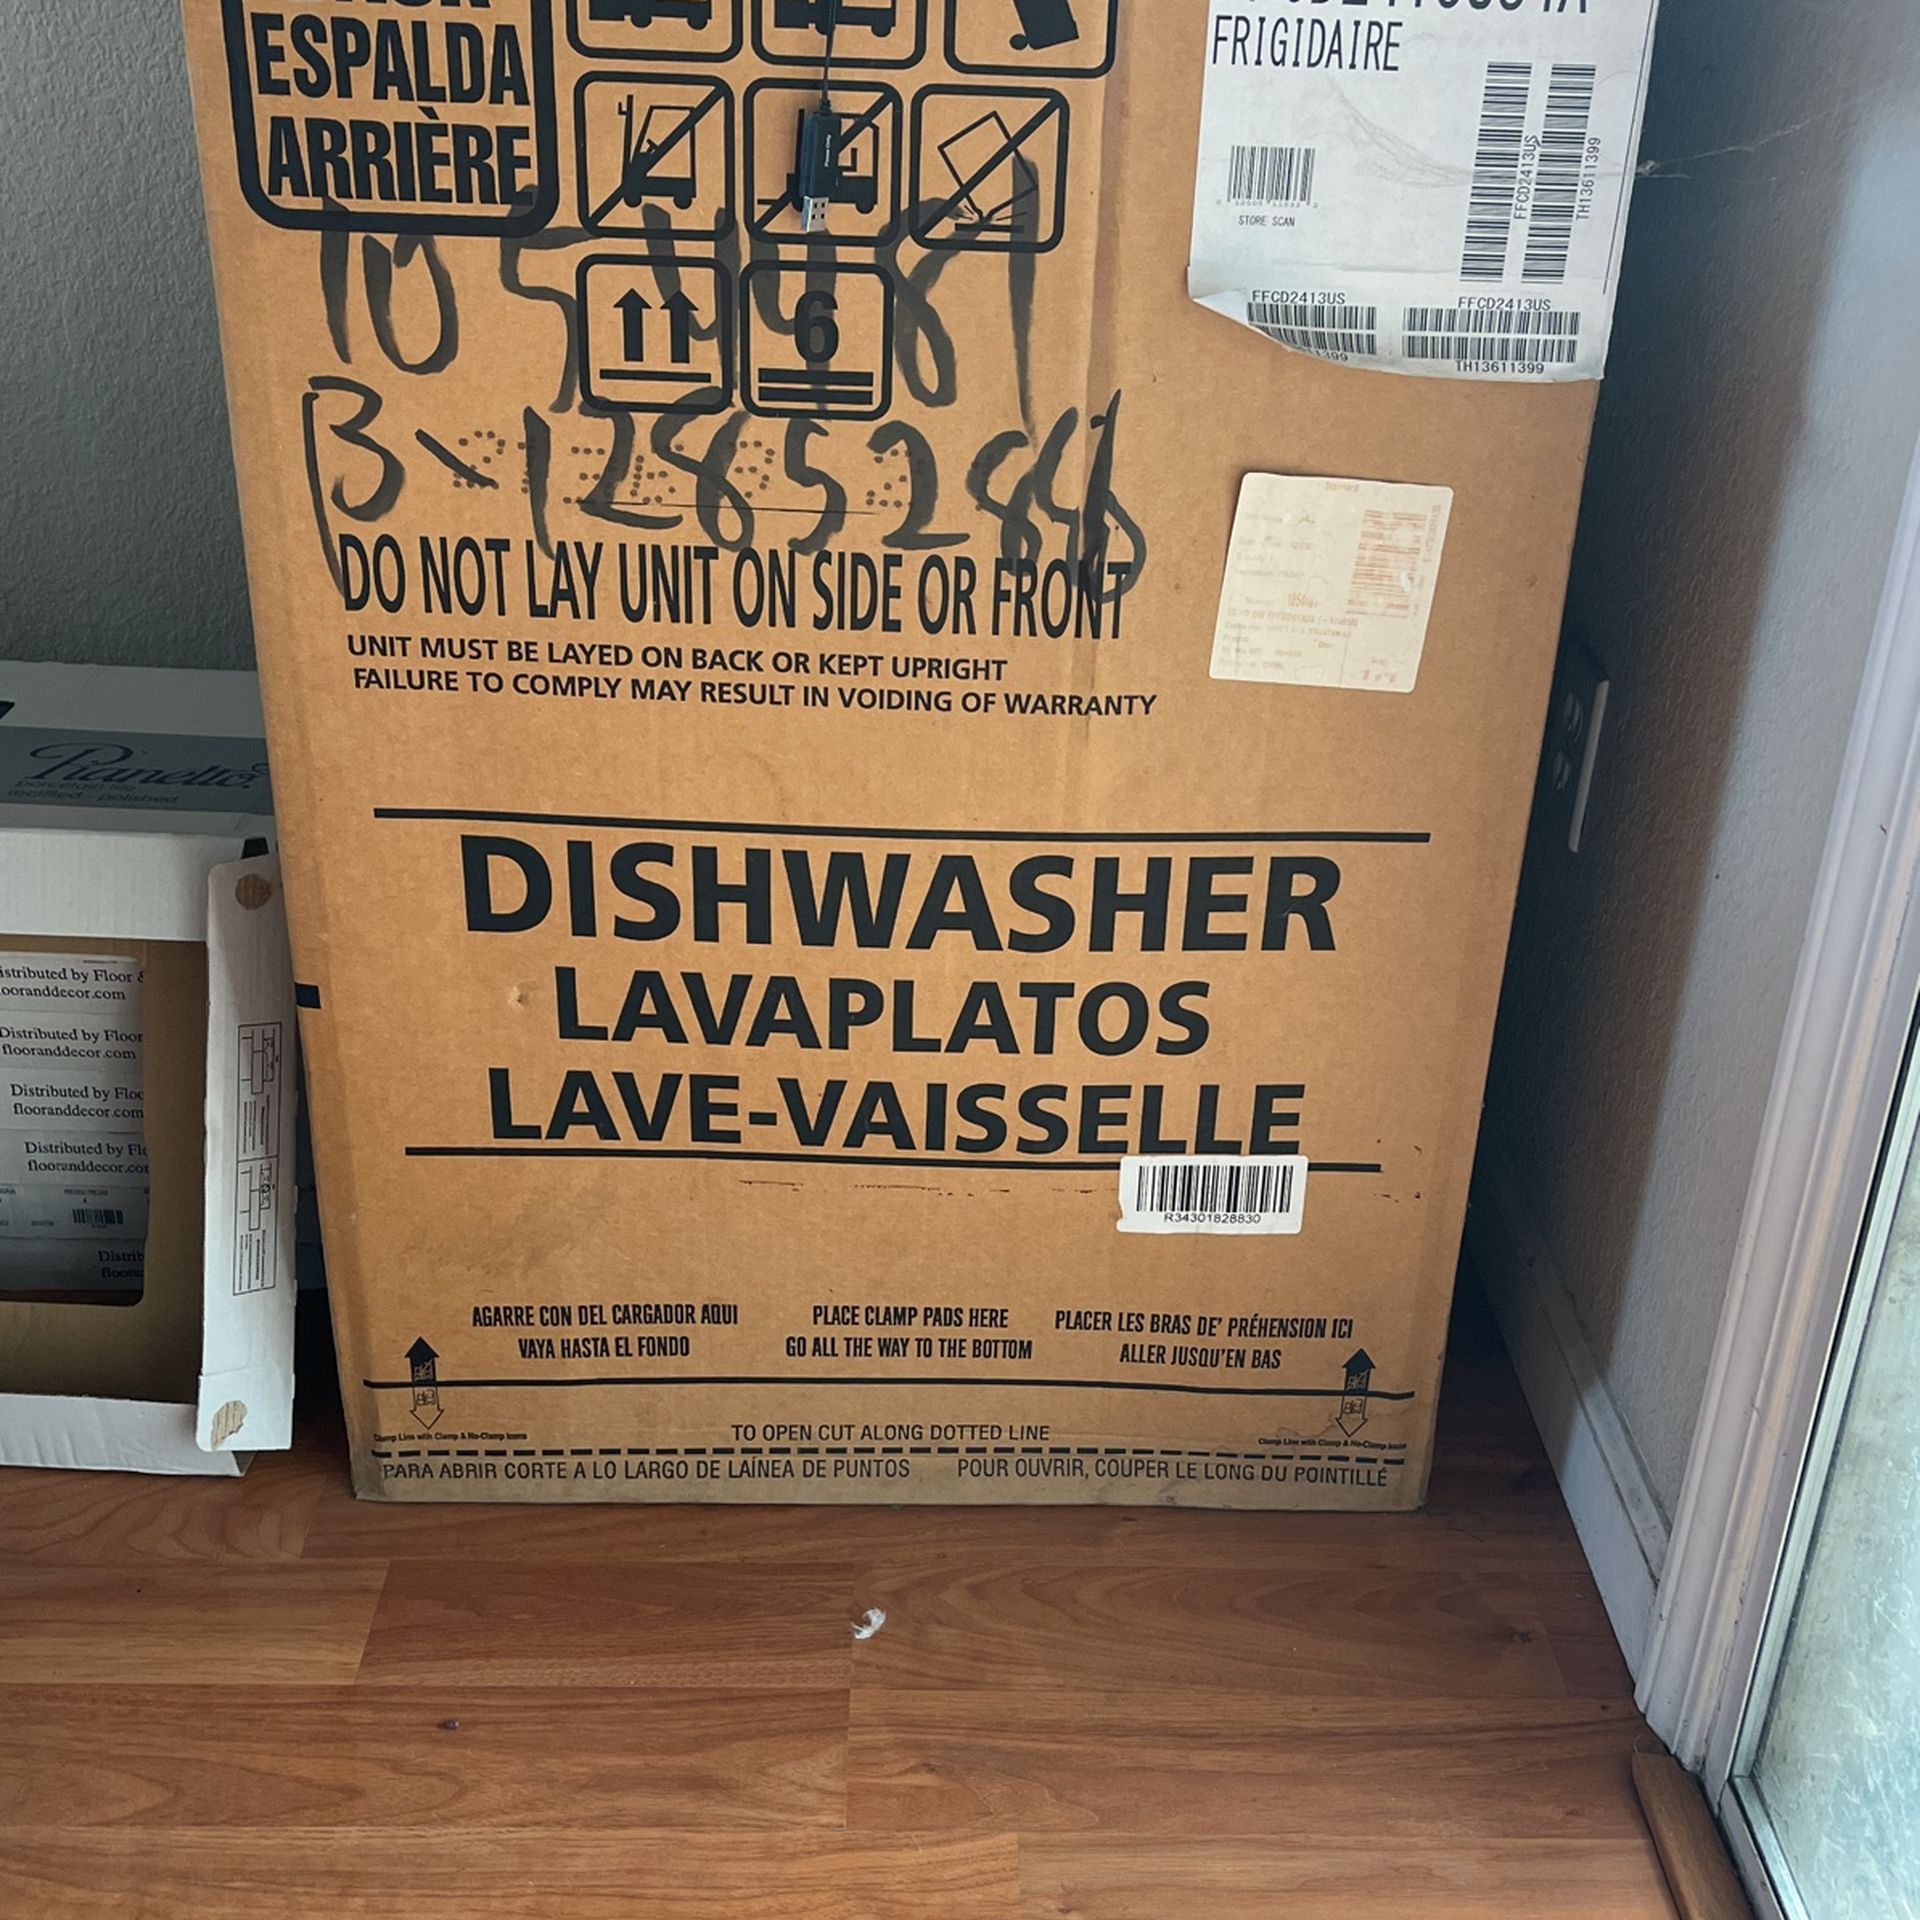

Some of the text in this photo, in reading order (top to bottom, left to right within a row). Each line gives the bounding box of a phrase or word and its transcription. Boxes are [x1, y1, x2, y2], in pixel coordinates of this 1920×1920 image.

[1212, 15, 1403, 71] FRIGIDAIRE
[250, 12, 530, 106] ESPALDA
[268, 105, 534, 205] ARRIÈRE
[1513, 135, 1537, 220] FFCD2413US
[1576, 137, 1600, 220] TH13611399
[1238, 215, 1295, 227] STORE SCAN
[1252, 290, 1346, 305] FFCD2413US
[1458, 296, 1551, 312] FFCD2413US
[793, 290, 840, 363] 6
[1455, 360, 1545, 375] TH13611399
[338, 533, 1132, 640] DO NOT LAY UNIT ON SIDE OR FRONT
[347, 634, 1008, 681] UNIT MUST BE LAYED ON BACK OR KEPT UPRIGHT
[353, 668, 1158, 717] FAILURE TO COMPLY MAY RESULT IN VOIDING OF WARRANTY
[459, 833, 1343, 953] DISHWASHER
[0, 966, 67, 981] istributed
[70, 968, 89, 983] by
[93, 969, 133, 983] Floor
[0, 985, 127, 1000] ooranddecor.com
[554, 965, 1211, 1057] LAVAPLATOS
[0, 1026, 143, 1044] Distributed by Floor
[2, 1043, 136, 1060] flooranddecor.com
[10, 1084, 89, 1099] Distributed
[92, 1087, 110, 1102] by
[14, 1102, 144, 1119] flooranddecor.com
[487, 1067, 1306, 1156] LAVE-VAISSELLE
[25, 1141, 103, 1156] Distributed
[106, 1143, 123, 1158] by
[1164, 1213, 1261, 1224] R34301828830
[98, 1250, 144, 1263] Distrib
[472, 1304, 738, 1327] AGARRE CON DEL CARGADOR AQUI
[813, 1305, 1009, 1329] PLACE CLAMP PADS HERE
[1055, 1310, 1112, 1331] PLACER
[1117, 1311, 1145, 1333] LES
[1150, 1313, 1192, 1335] BRAS
[1227, 1313, 1327, 1339] PRÉHENSION
[1331, 1318, 1353, 1340] ICI
[518, 1335, 690, 1359] VAYA HASTA EL FONDO
[785, 1336, 1033, 1360] GO ALL THE WAY TO THE BOTTOM
[1120, 1343, 1282, 1370] ALLER JUSQU'EN BAS
[373, 1433, 397, 1443] Clamp
[398, 1432, 415, 1441] Line
[417, 1432, 433, 1441] with
[434, 1432, 458, 1442] Clamp
[468, 1432, 505, 1442] No-Clamp
[732, 1424, 1050, 1442] TO OPEN CUT ALONG DOTTED LINE
[1258, 1438, 1282, 1447] Clamp
[1283, 1438, 1300, 1447] Line
[1301, 1438, 1316, 1446] with
[1318, 1438, 1343, 1448] Clamp
[1350, 1440, 1387, 1450] No-Clamp
[383, 1462, 434, 1480] PARA
[439, 1462, 497, 1479] ABRIR
[504, 1462, 567, 1479] CORTE
[573, 1462, 587, 1479] A
[593, 1461, 617, 1479] LO
[624, 1461, 689, 1479] LARGO
[696, 1459, 721, 1479] DE
[802, 1459, 827, 1478] DE
[834, 1458, 910, 1478] PUNTOS
[957, 1459, 1389, 1487] POUR OUVRIR, COUPER LE LONG DU POINTILLÉ
